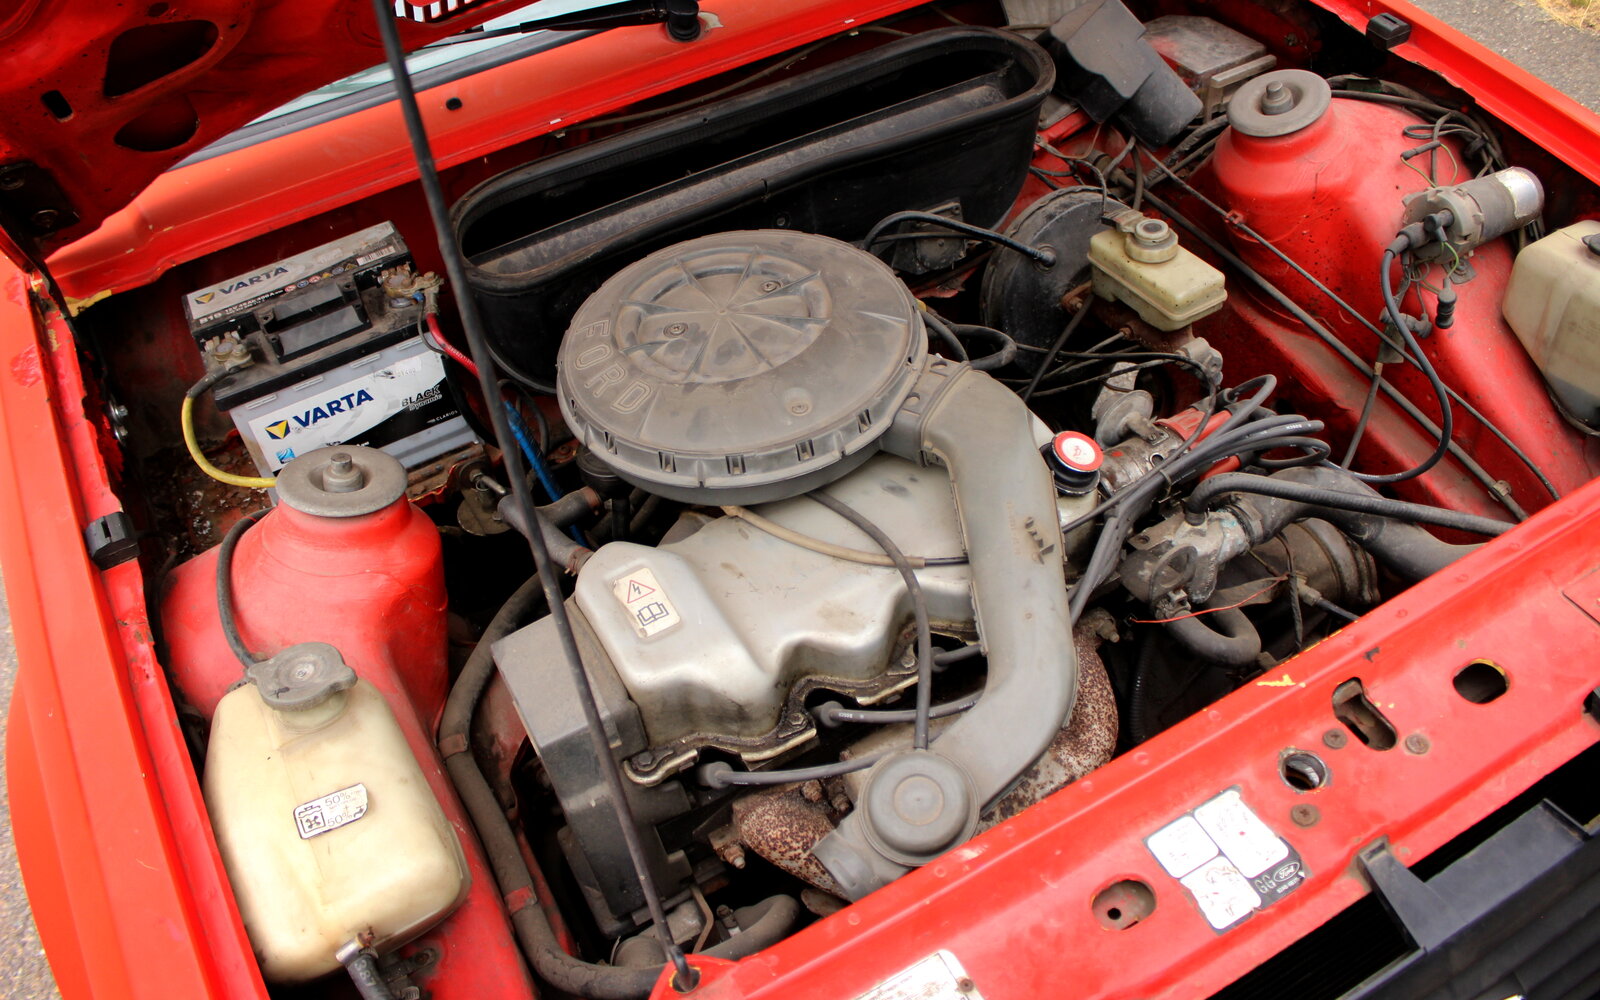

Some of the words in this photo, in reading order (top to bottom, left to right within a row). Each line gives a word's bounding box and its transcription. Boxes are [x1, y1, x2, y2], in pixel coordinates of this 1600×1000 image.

[219, 266, 289, 295] VARTA
[574, 319, 653, 414] FORD
[402, 384, 441, 407] BLACK
[292, 388, 375, 428] VARTA
[436, 410, 459, 421] CLARIOS
[325, 792, 351, 807] 50%
[327, 811, 353, 827] 50%
